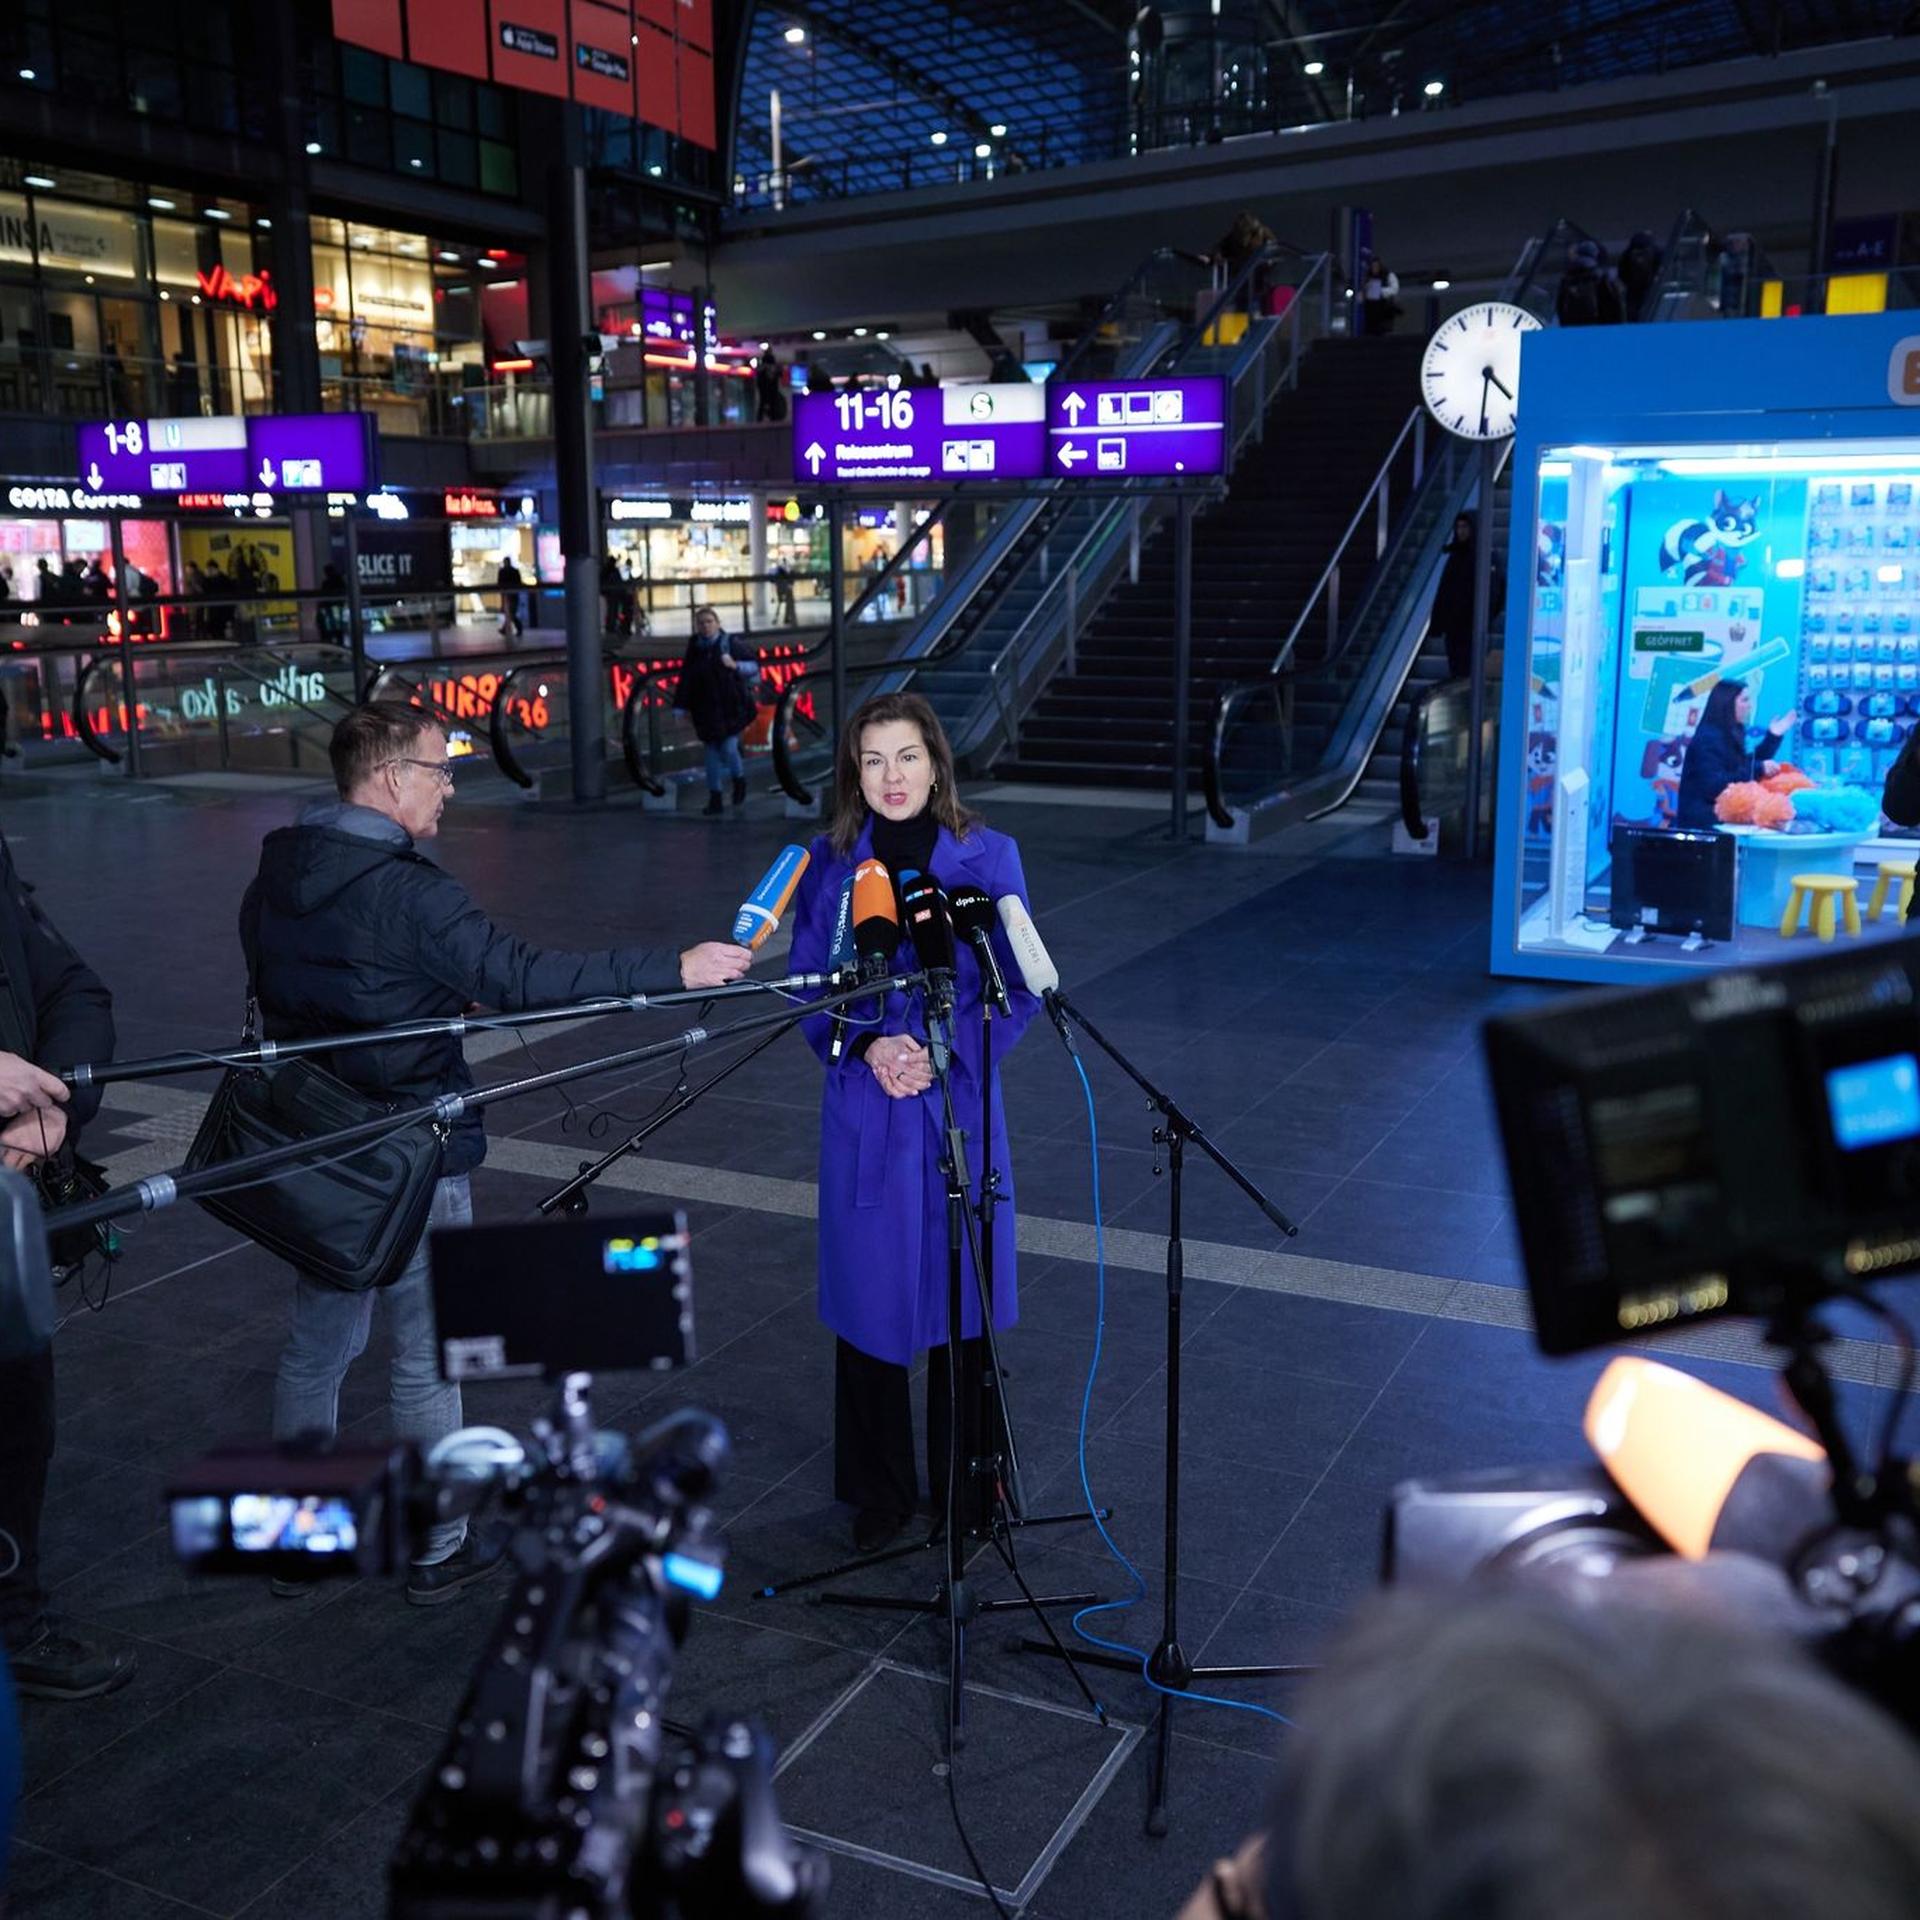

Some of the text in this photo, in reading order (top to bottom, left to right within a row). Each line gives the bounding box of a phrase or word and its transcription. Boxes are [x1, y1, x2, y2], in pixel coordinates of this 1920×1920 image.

[835, 391, 914, 430] 11-16
[972, 393, 992, 419] S
[104, 422, 143, 455] 1-8
[9, 487, 70, 509] COSTA
[357, 554, 412, 575] SLICE IT
[1645, 634, 1692, 646] GEÖFFNET
[516, 696, 549, 729] 36
[955, 896, 976, 908] dpa
[832, 891, 850, 955] newstime
[1020, 927, 1041, 964] REUTERS
